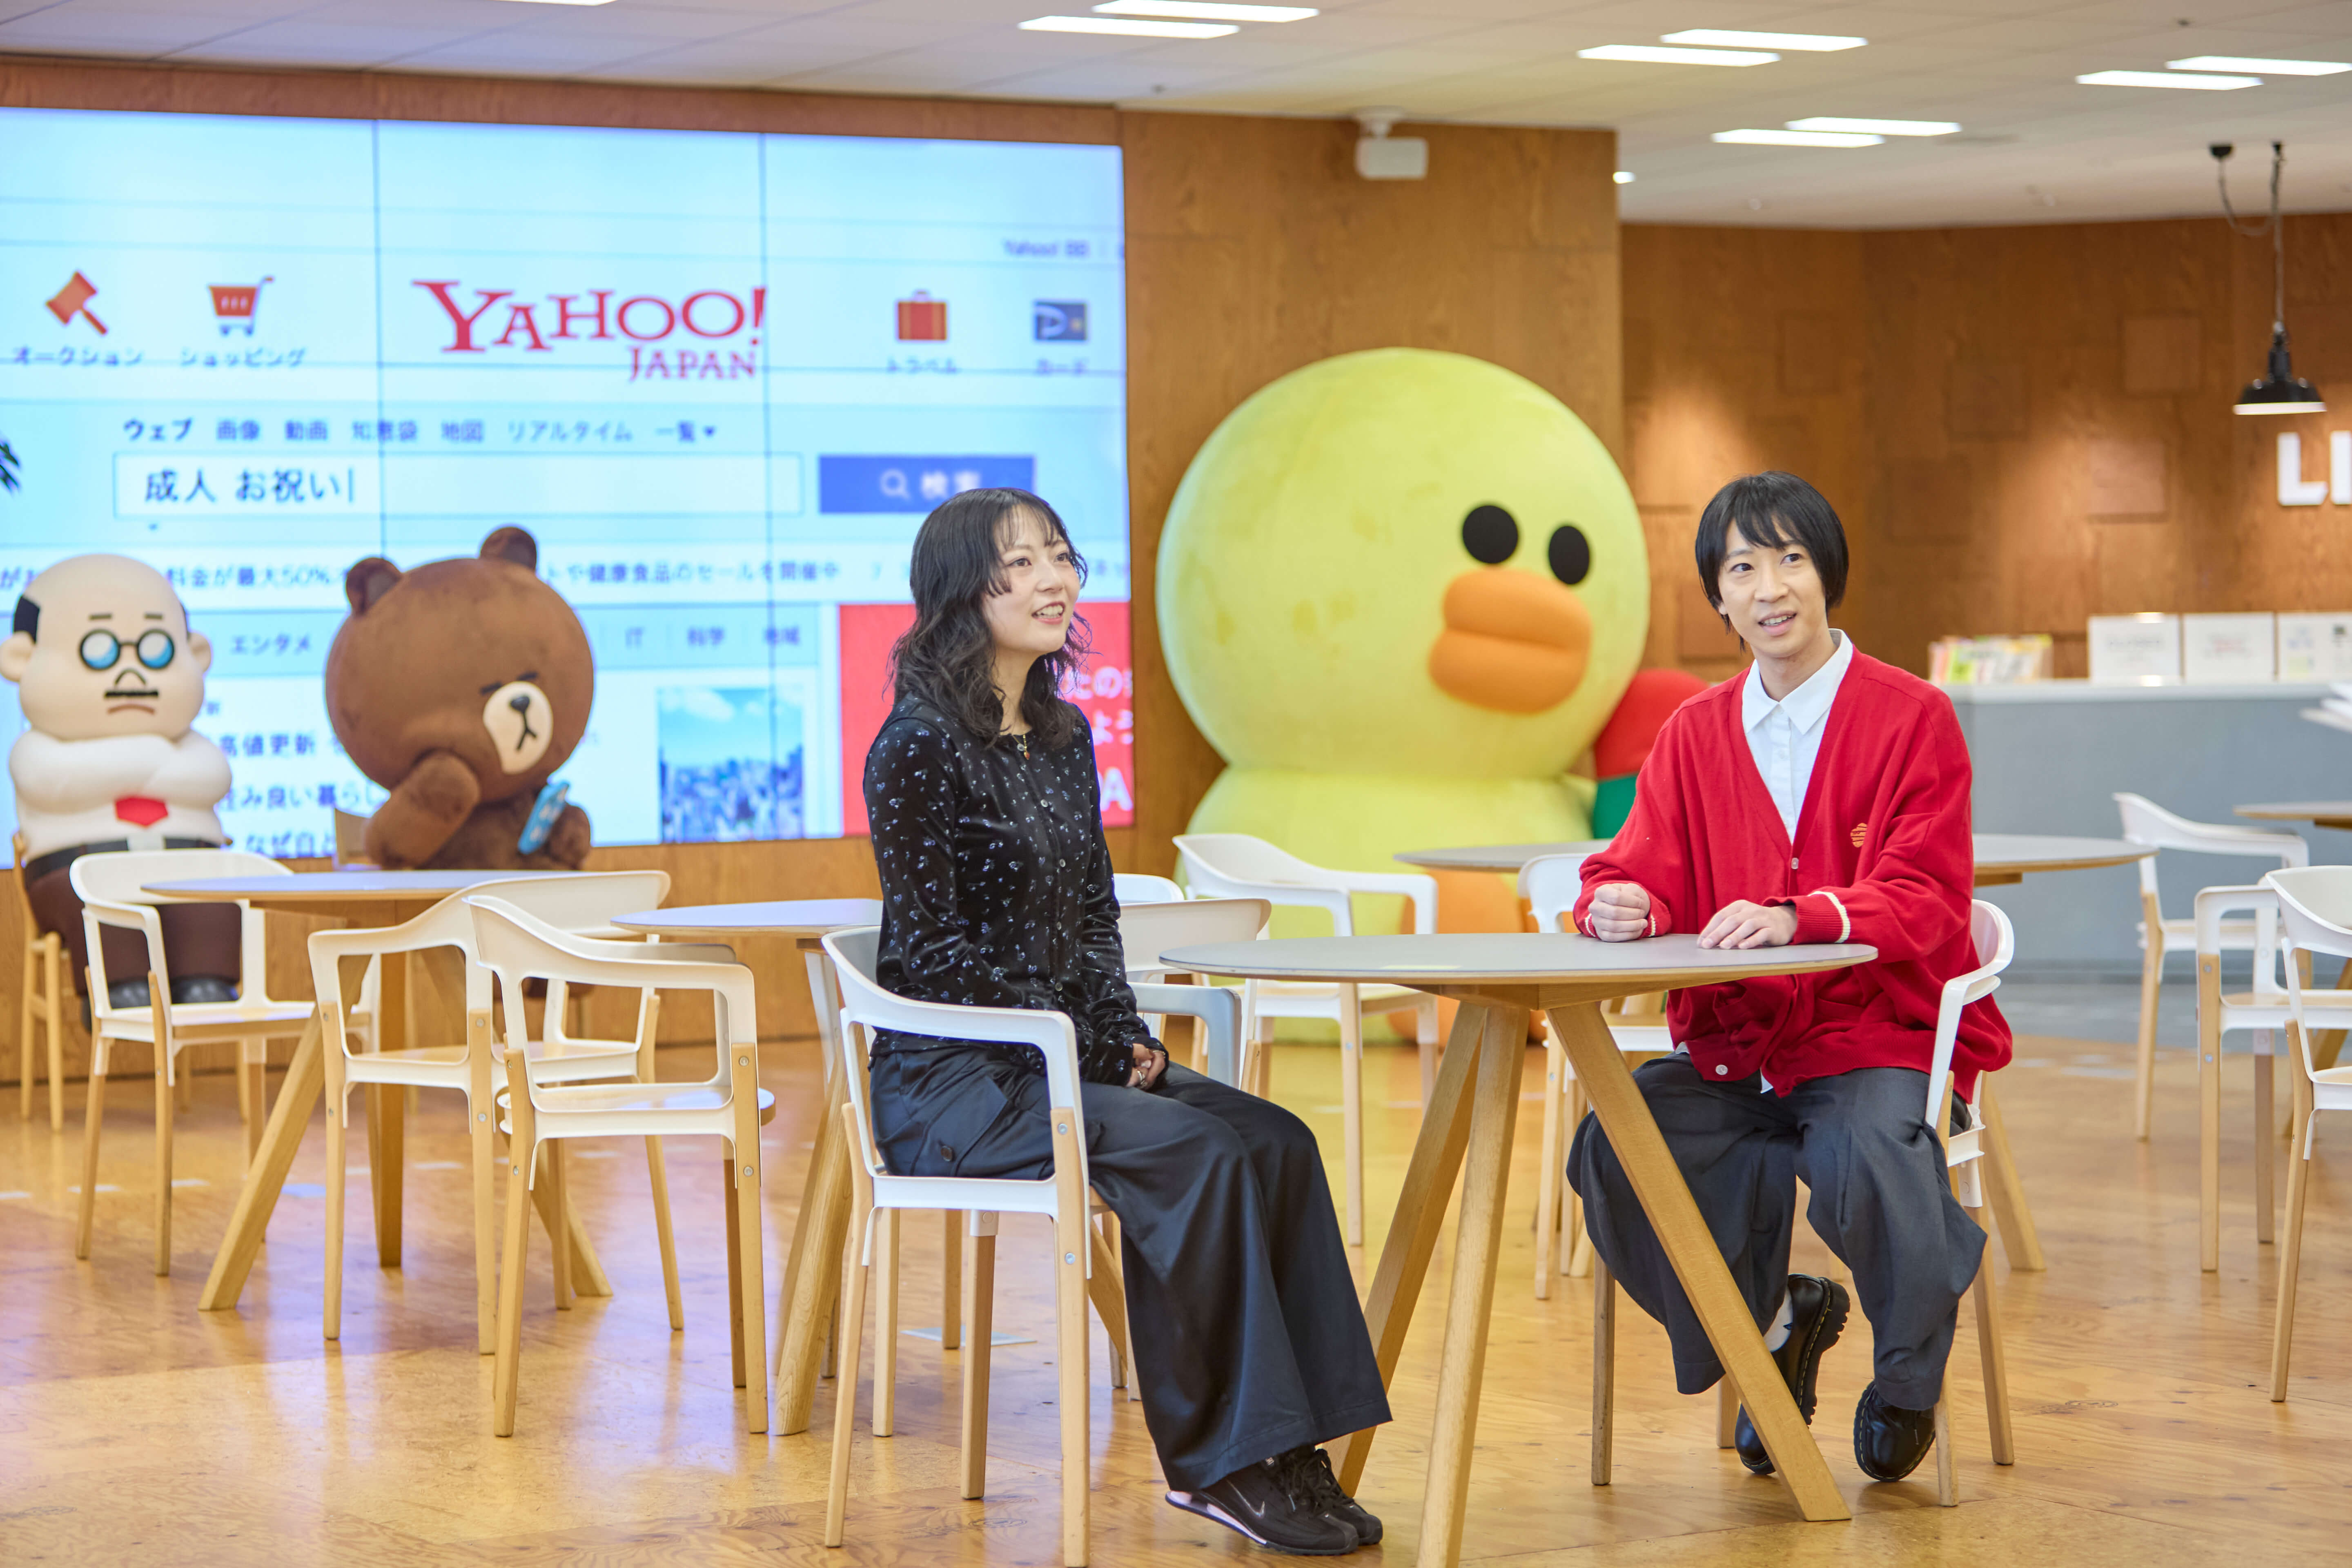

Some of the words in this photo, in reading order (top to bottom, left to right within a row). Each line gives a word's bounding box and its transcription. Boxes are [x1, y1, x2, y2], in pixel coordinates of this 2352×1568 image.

[411, 279, 766, 352] YAHOO!
[13, 346, 143, 367] オークション
[180, 346, 306, 368] ショッピング
[630, 344, 756, 381] JAPAN
[124, 417, 193, 440] ウェブ
[216, 420, 260, 441] 画像
[285, 420, 328, 441] 動画
[441, 420, 484, 442] 地図
[509, 421, 632, 441] リアルタイム
[145, 469, 216, 503] 成人
[235, 468, 341, 503] お祝い
[231, 633, 310, 655] エンタメ
